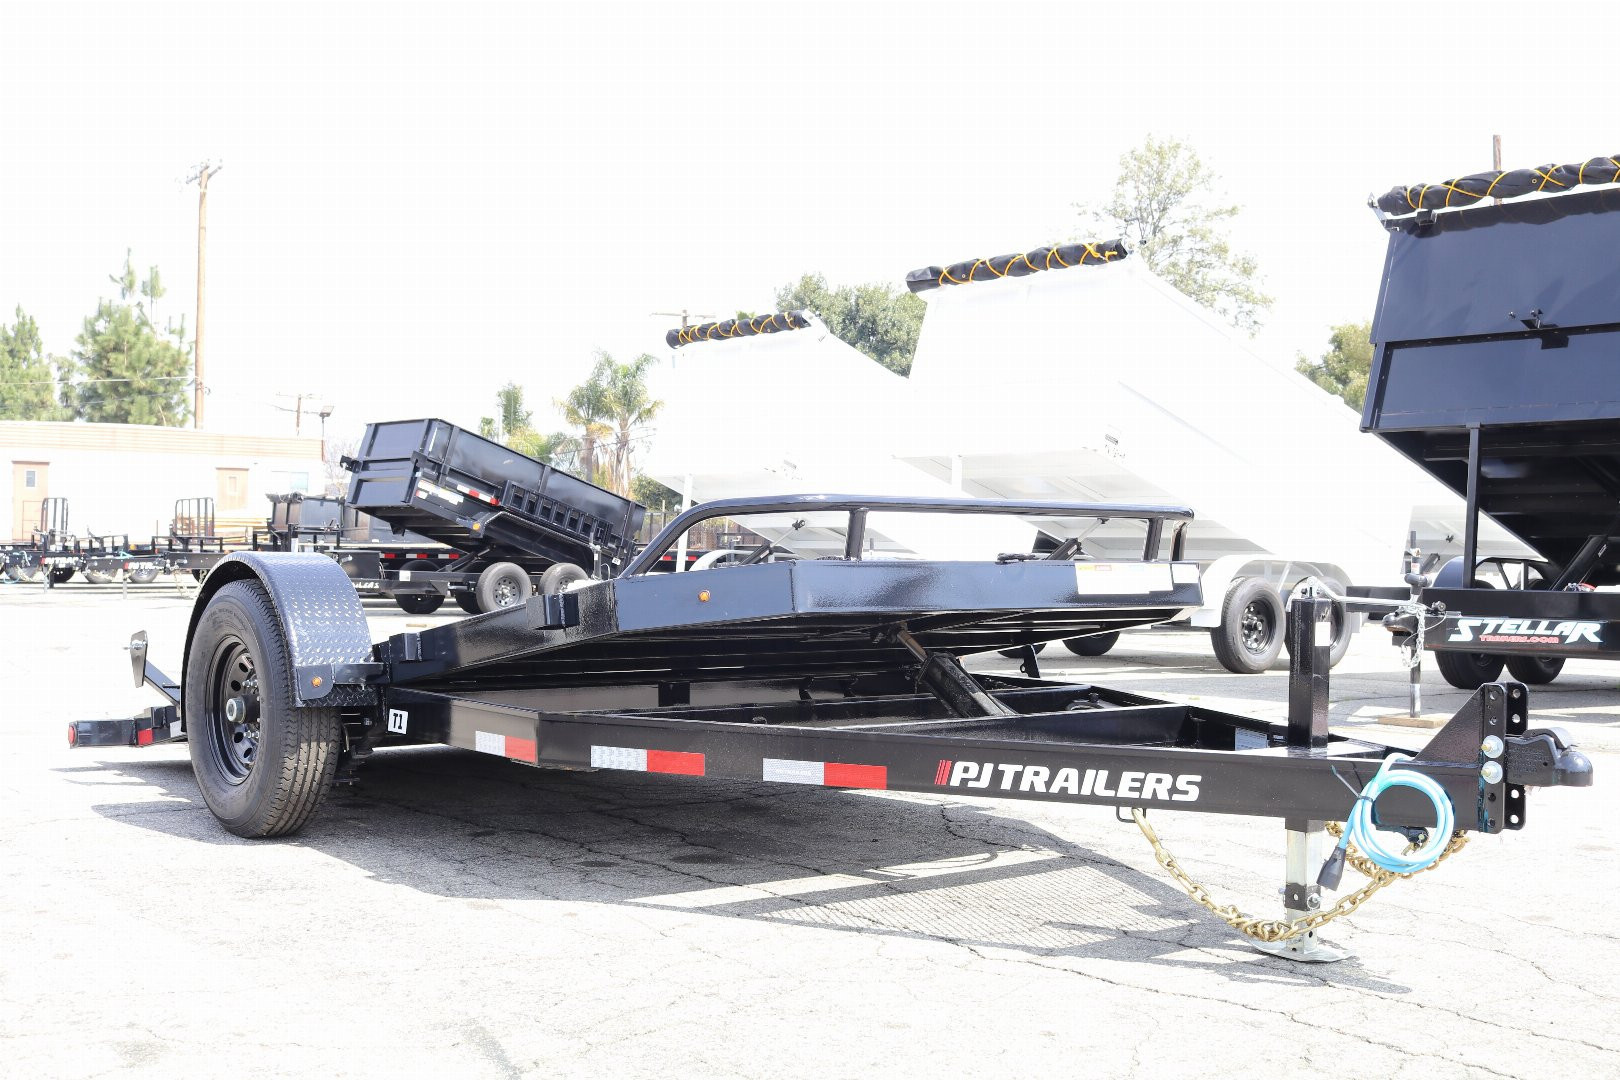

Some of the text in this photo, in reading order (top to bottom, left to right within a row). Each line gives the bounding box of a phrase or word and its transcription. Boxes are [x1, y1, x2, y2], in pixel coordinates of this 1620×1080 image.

[1448, 618, 1603, 644] STELLAR
[393, 712, 403, 730] T1
[949, 761, 1202, 802] PJ TRAILERS
